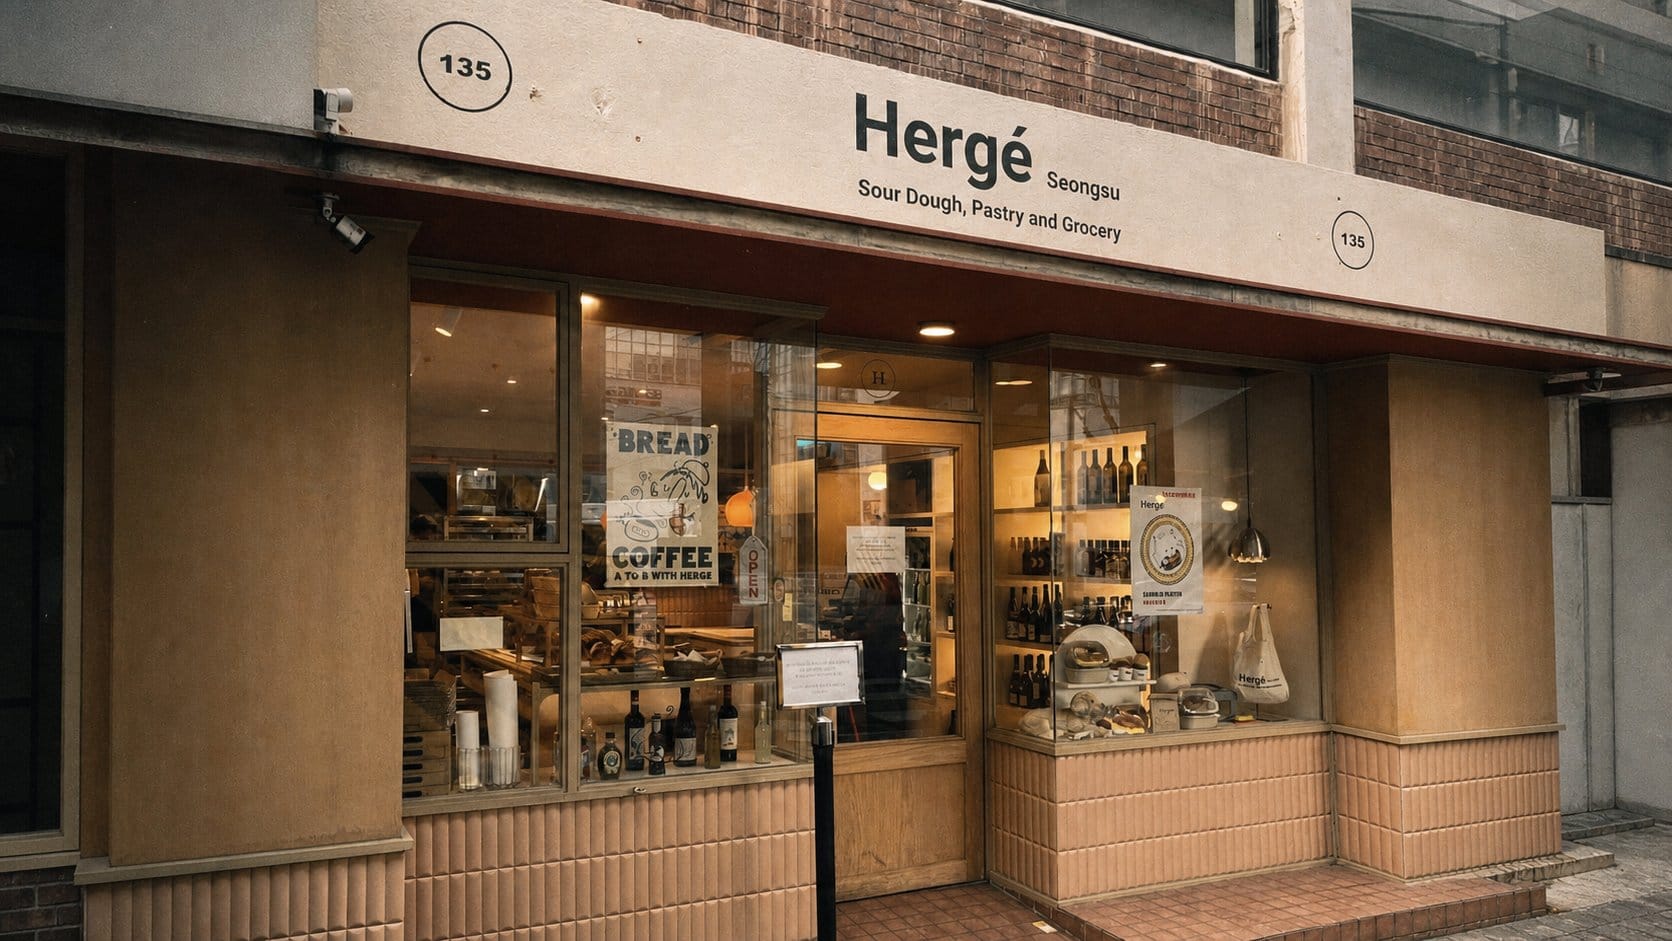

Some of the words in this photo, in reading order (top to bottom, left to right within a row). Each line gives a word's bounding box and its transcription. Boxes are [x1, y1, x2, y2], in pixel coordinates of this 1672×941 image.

[439, 54, 492, 81] 135
[855, 92, 1033, 191] Hergé
[1047, 171, 1120, 201] Seongsu
[858, 179, 902, 202] Sour
[906, 187, 967, 217] Dough,
[972, 199, 1025, 228] Pastry
[1028, 213, 1058, 230] and
[1062, 216, 1122, 245] Grocery
[1341, 232, 1365, 249] 135
[872, 371, 885, 385] H
[618, 428, 710, 457] BREAD
[612, 546, 713, 569] COFFEE
[614, 571, 623, 581] A
[624, 571, 639, 581] TO
[641, 571, 649, 581] B
[651, 571, 678, 581] WITH
[679, 571, 713, 581] HERGE
[749, 550, 759, 598] OPEN
